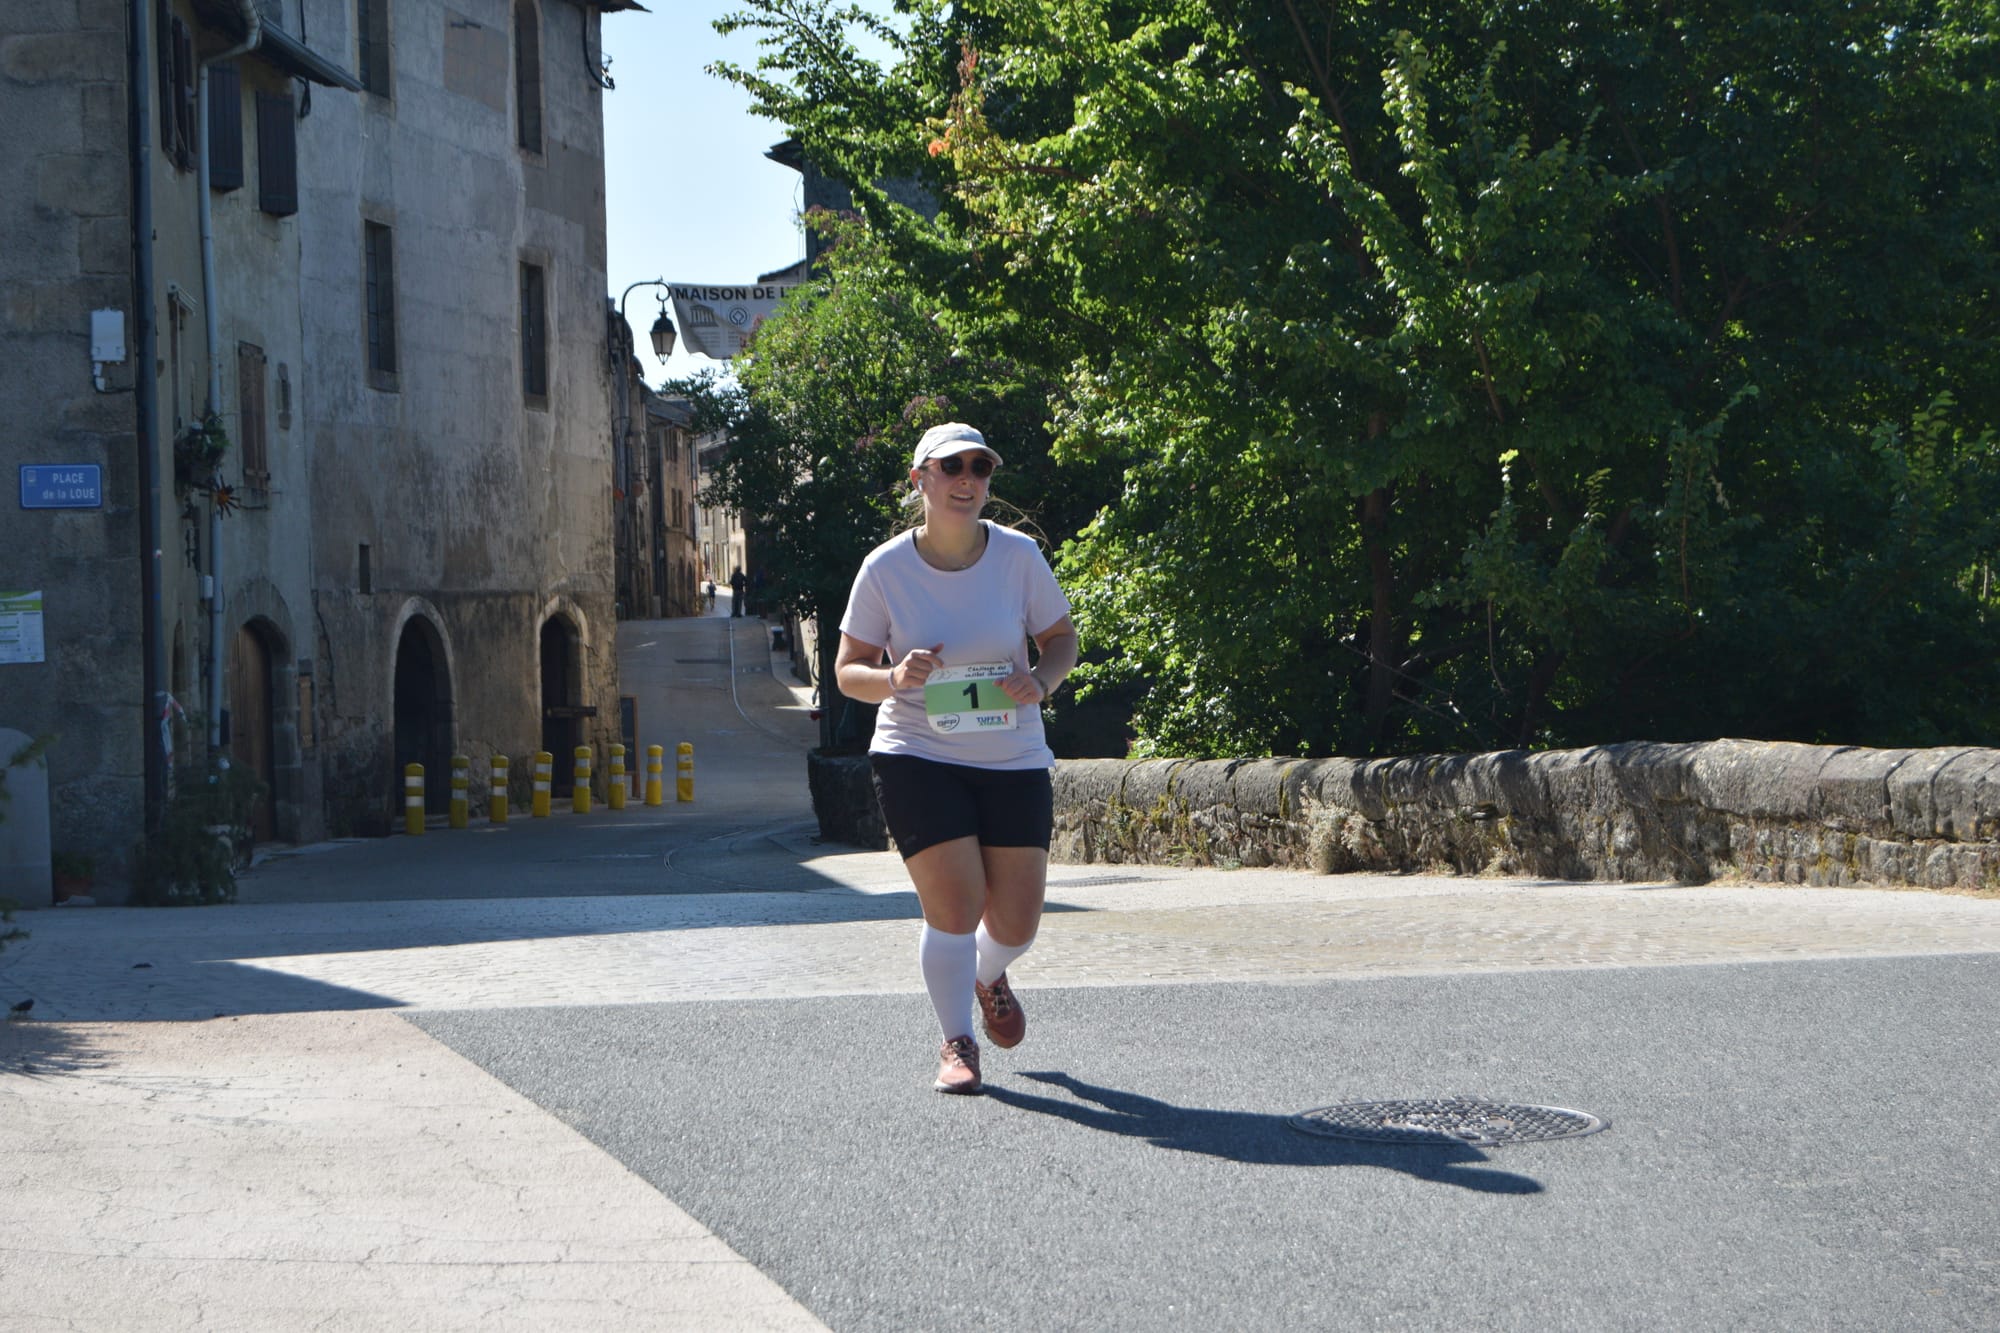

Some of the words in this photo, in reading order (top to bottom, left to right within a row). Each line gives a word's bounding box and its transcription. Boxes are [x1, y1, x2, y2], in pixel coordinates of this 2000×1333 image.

[675, 287, 747, 301] MAISON
[753, 286, 776, 299] DE
[52, 473, 85, 484] PLACE
[42, 489, 54, 499] de
[57, 489, 66, 499] la
[70, 488, 96, 499] LOUE
[962, 682, 980, 709] 1
